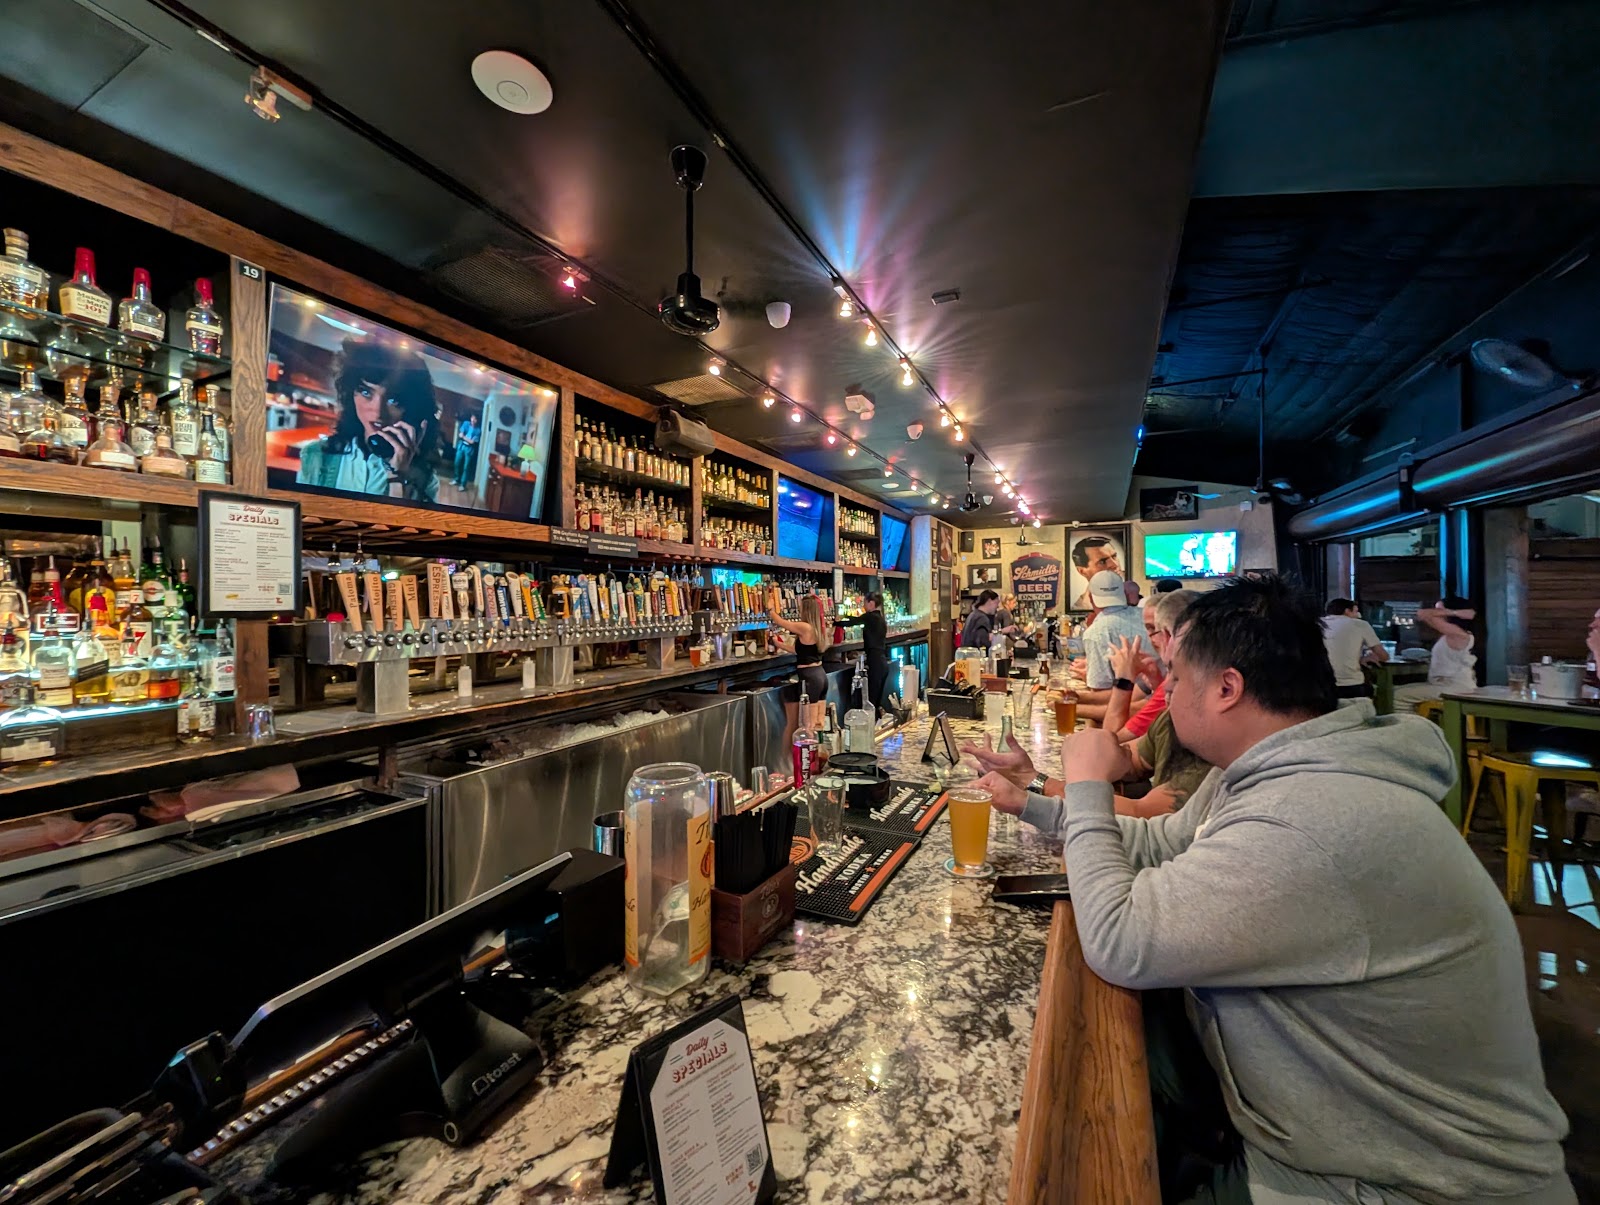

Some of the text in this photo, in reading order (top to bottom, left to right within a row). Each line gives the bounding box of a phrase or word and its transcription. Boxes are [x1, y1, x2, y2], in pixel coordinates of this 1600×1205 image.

[243, 265, 260, 279] 19
[228, 513, 280, 526] SPECIALS
[243, 504, 265, 515] Daily
[133, 594, 140, 602] 7
[346, 576, 357, 609] Paloma
[371, 576, 381, 606] Mojito
[406, 577, 417, 601] Mule
[431, 566, 442, 614] ESPRESSO
[1018, 583, 1053, 593] BEER
[128, 631, 146, 656] 7
[795, 834, 865, 895] Handmade
[835, 853, 873, 882] VODKA
[848, 849, 893, 895] AUSTIN TEXAS
[685, 1036, 709, 1056] Daily
[486, 1052, 522, 1083] toast
[672, 1041, 728, 1084] SPECIALS
